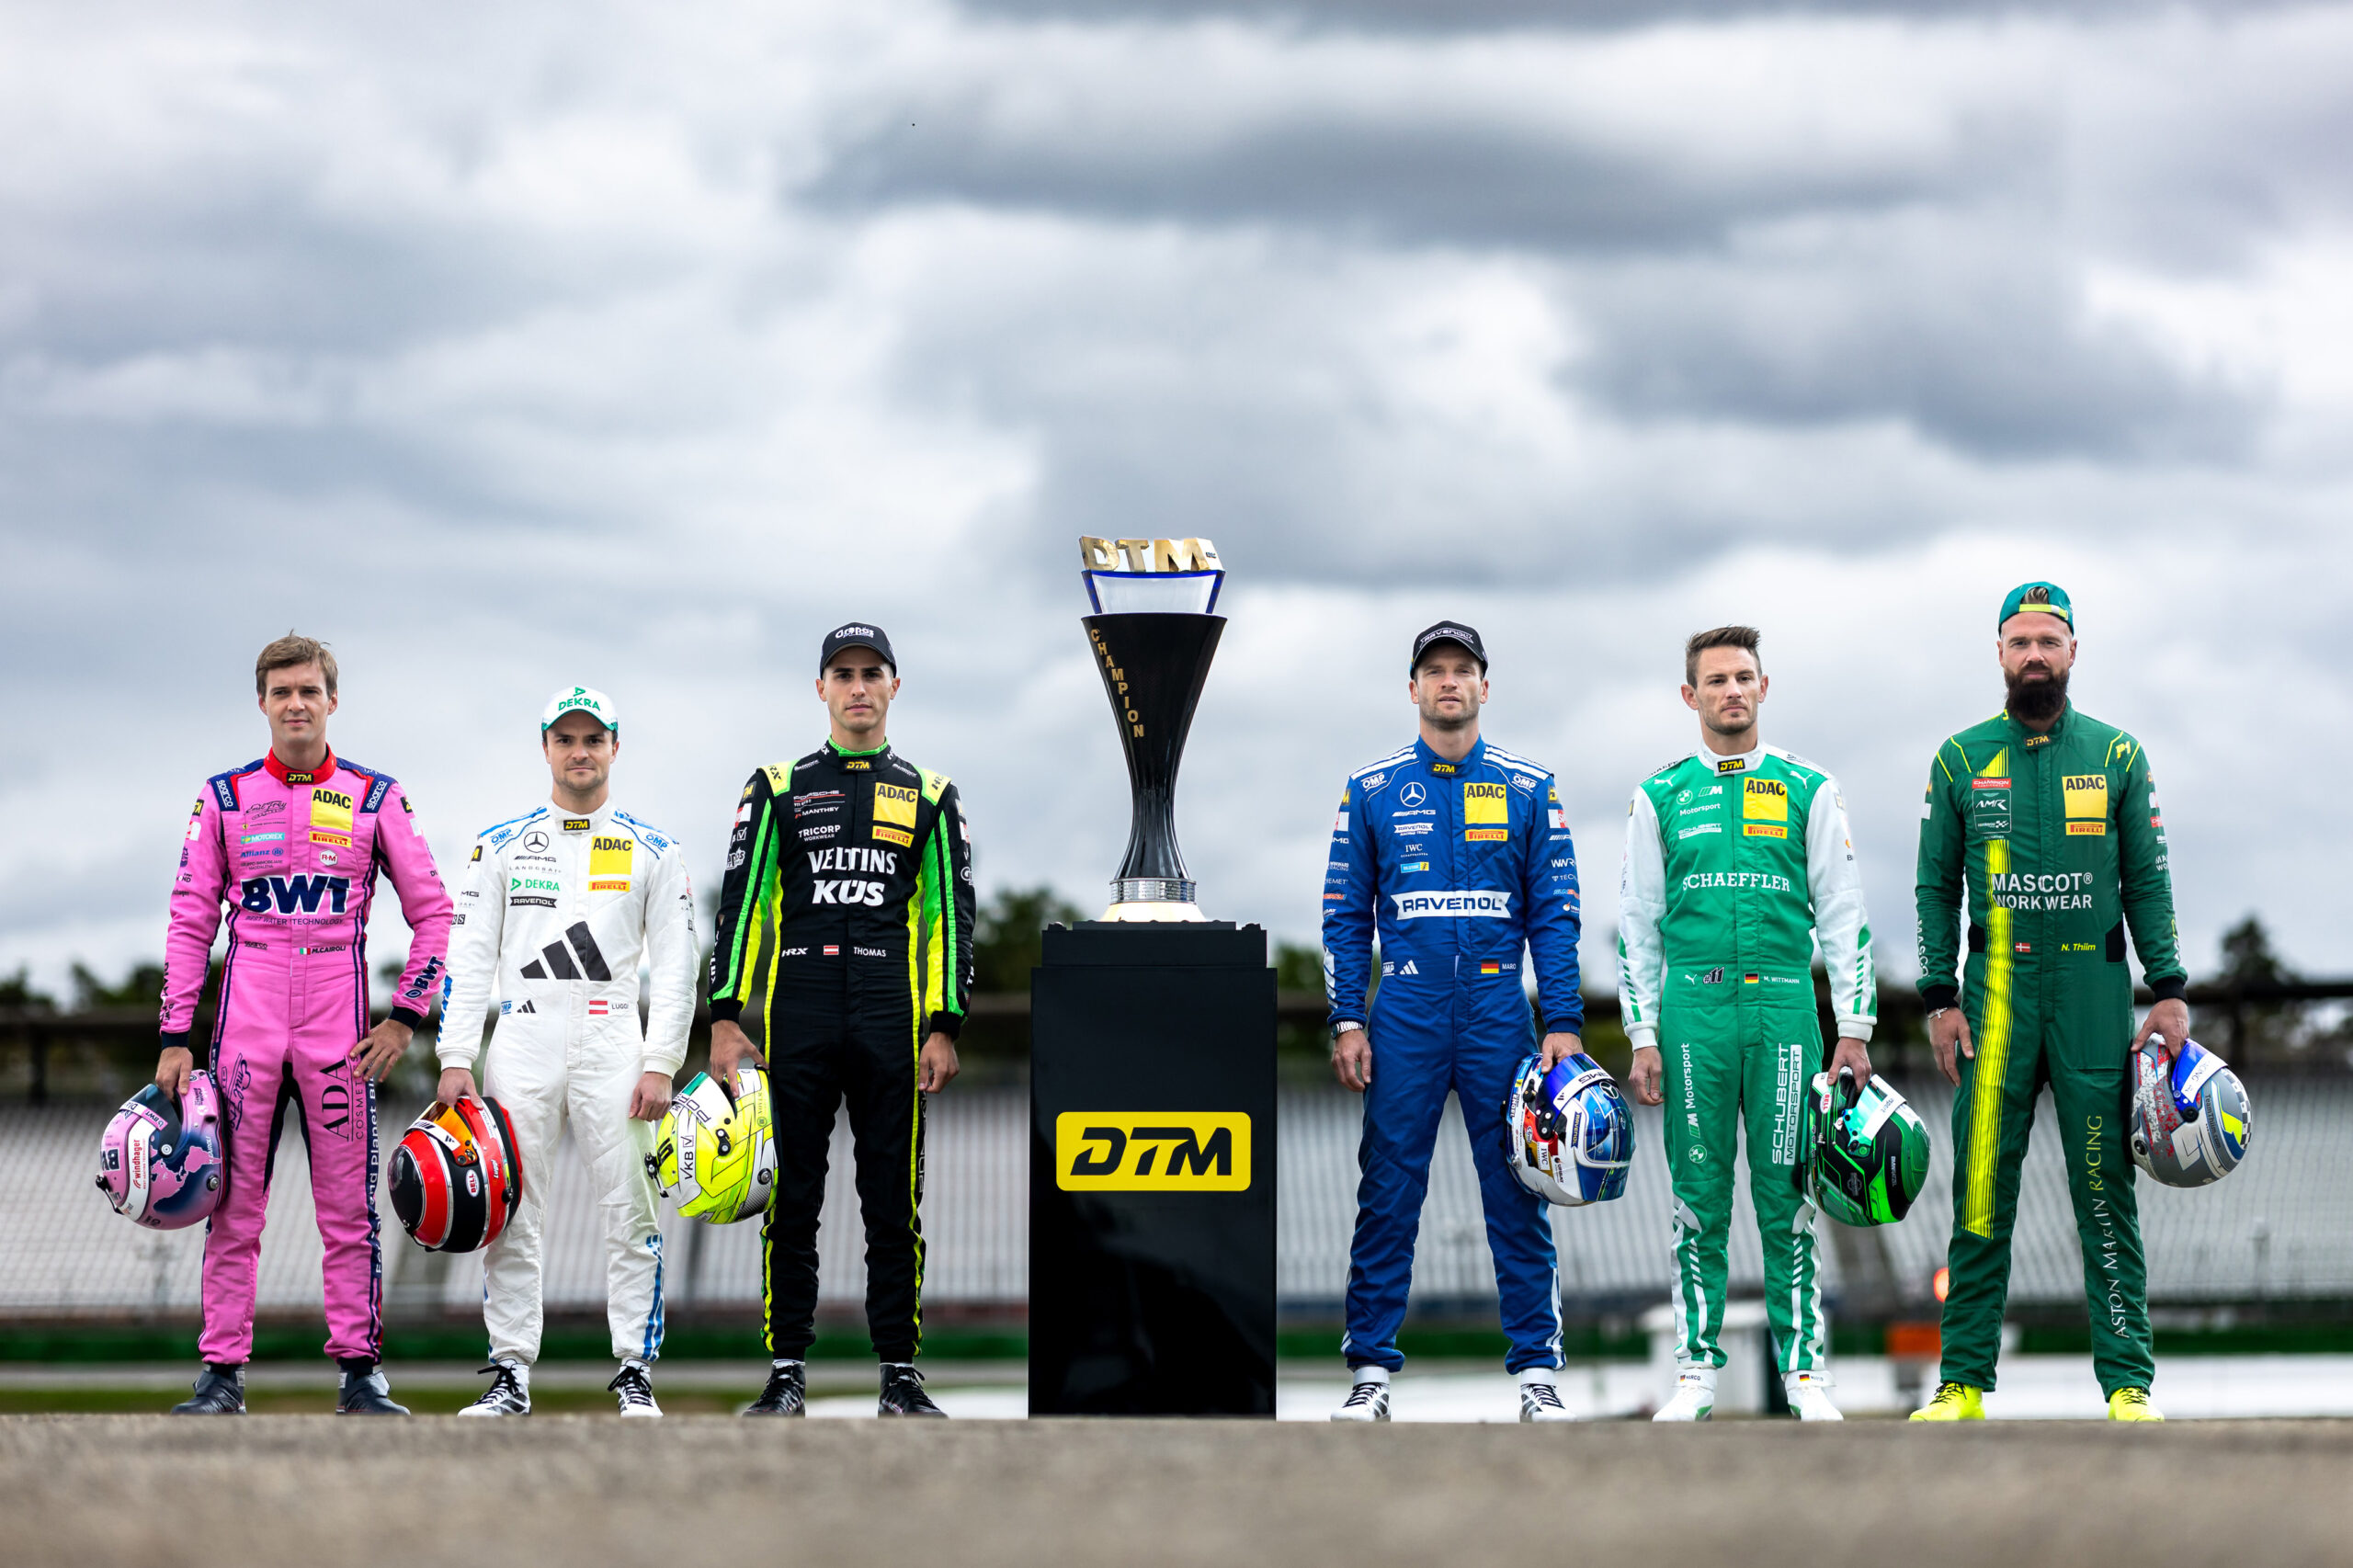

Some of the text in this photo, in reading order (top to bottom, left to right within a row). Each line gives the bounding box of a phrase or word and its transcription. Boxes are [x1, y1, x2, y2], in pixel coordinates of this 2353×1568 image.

[1079, 535, 1219, 572] DTM
[1091, 629, 1144, 737] CHAMPION
[558, 698, 601, 711] DEKRA
[2026, 735, 2049, 746] DTM
[847, 761, 870, 769] DTM
[1433, 764, 1455, 773] DTM
[1720, 760, 1744, 771] DTM
[288, 774, 313, 782] DTM
[1362, 774, 1385, 789] OMP
[1513, 775, 1536, 789] OMP
[2065, 777, 2105, 790] ADAC
[217, 779, 233, 807] sparco
[877, 785, 916, 802] ADAC
[1466, 785, 1505, 799] ADAC
[1745, 779, 1786, 796] ADAC
[313, 790, 351, 809] ADAC
[367, 780, 386, 810] sparco
[793, 790, 840, 801] PORSCHE
[801, 807, 839, 816] MANTHEY
[1679, 803, 1721, 816] Motorsport
[1976, 800, 2007, 811] AMR
[565, 821, 588, 830] DTM
[798, 824, 841, 838] TRICORP
[1678, 824, 1722, 834] SCHUBERT
[1748, 826, 1784, 837] PIRELLI
[2070, 824, 2103, 834] PIRELLI
[251, 833, 283, 842] MOTOREX
[313, 833, 348, 846] PIRELLI
[491, 829, 512, 844] OMP
[645, 835, 668, 849] OMP
[803, 834, 835, 842] WORKWEAR
[875, 828, 909, 844] PIRELLI
[1469, 831, 1505, 839] PIRELLI
[593, 838, 632, 851] ADAC
[1405, 844, 1423, 853] IWC
[240, 849, 270, 858] Allianz
[807, 847, 898, 875] VELTINS
[525, 879, 561, 892] DEKRA
[592, 881, 627, 891] PIRELLI
[1683, 872, 1790, 892] SCHAEFFLER
[240, 872, 352, 915] BWT
[812, 880, 885, 906] KÜS
[514, 898, 553, 906] RAVENOL
[1403, 897, 1502, 913] RAVENOL
[1993, 894, 2092, 910] WORKWEAR
[263, 916, 287, 925] WATER
[781, 948, 809, 958] HRX
[853, 947, 887, 958] THOMAS
[2073, 943, 2097, 951] Thiim
[413, 956, 444, 990] BWT
[1703, 966, 1725, 984] #11
[1771, 976, 1800, 984] WITTMANN
[233, 1060, 251, 1100] Emil
[1681, 1043, 1696, 1109] Motorsport
[319, 1055, 349, 1142] ADA
[354, 1055, 364, 1140] COSMETS
[1772, 1043, 1789, 1165] SCHUBERT
[1786, 1051, 1801, 1159] MOTORSPORT
[370, 1108, 379, 1166] Planet
[1070, 1127, 1233, 1176] DTM
[2086, 1115, 2103, 1191] RACING
[132, 1140, 142, 1179] windhager
[680, 1151, 693, 1179] VKB
[2107, 1279, 2130, 1338] ASTON
